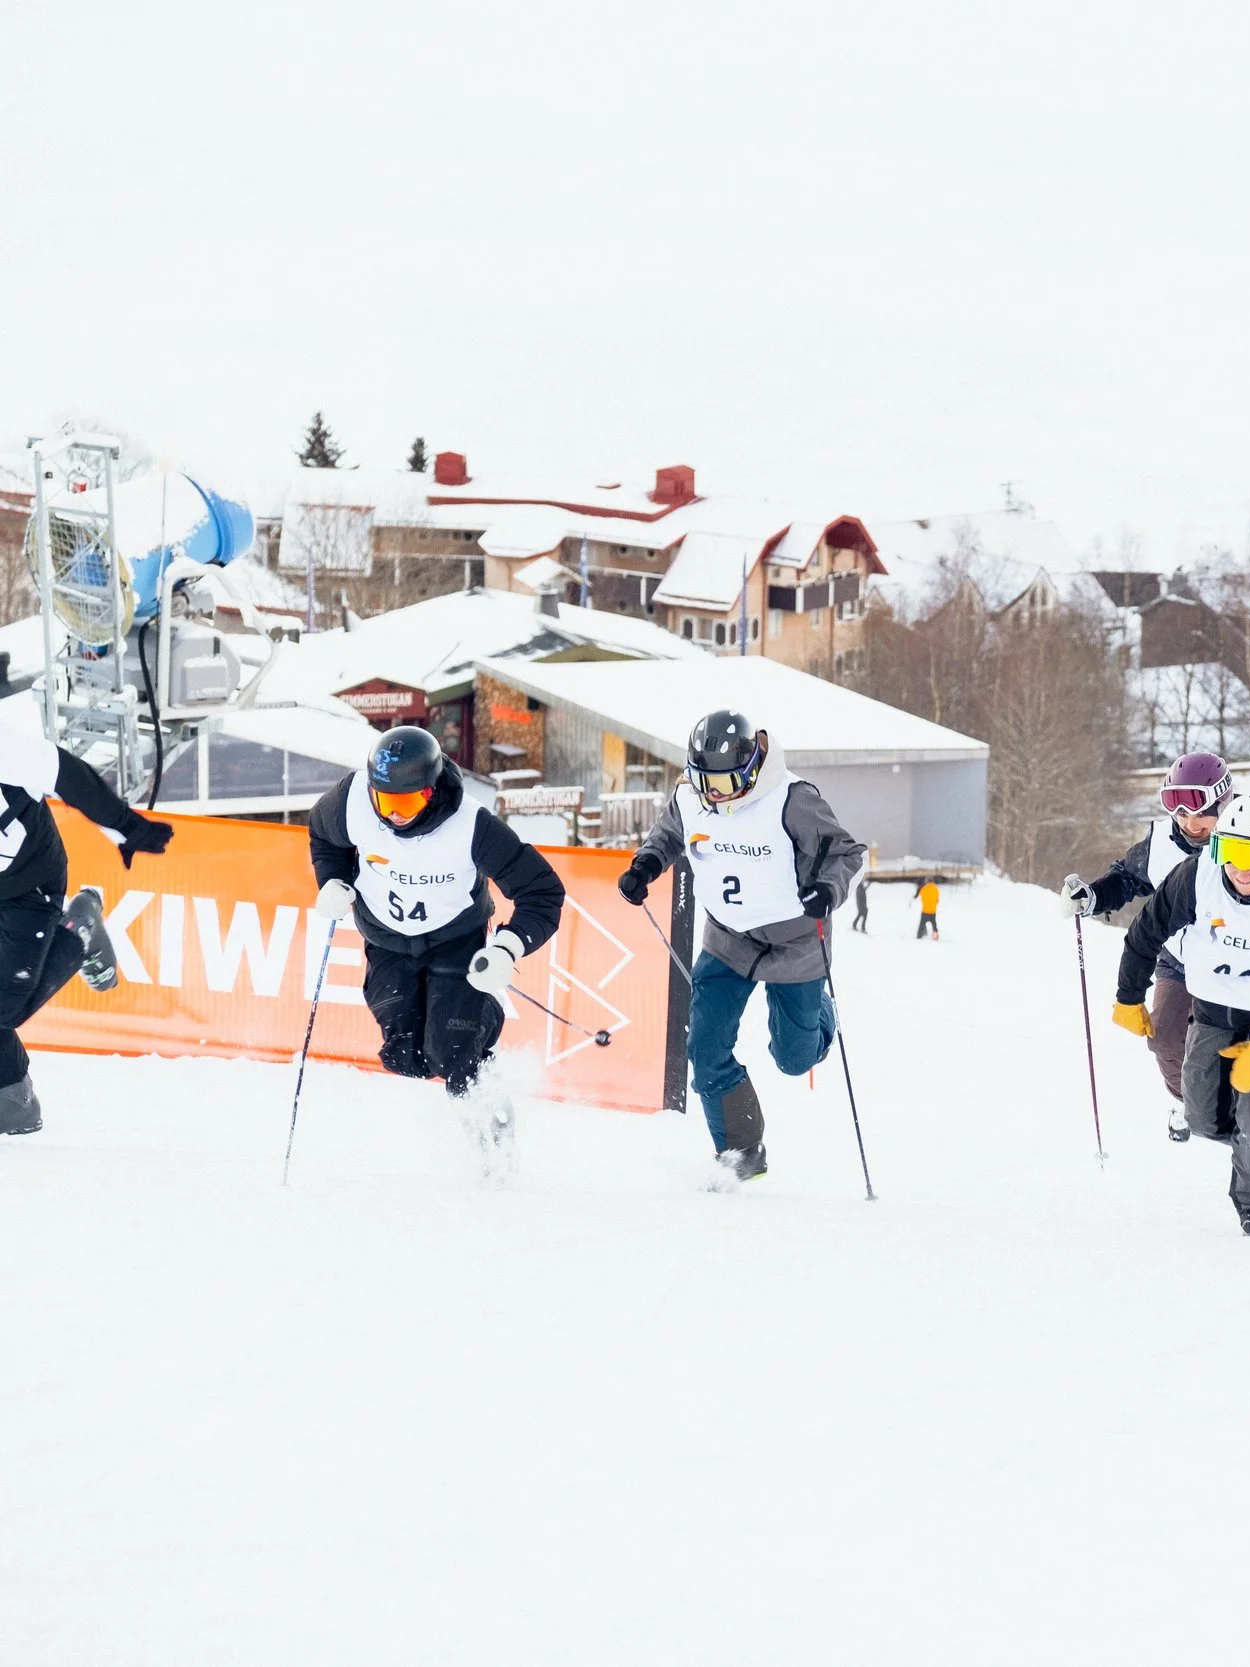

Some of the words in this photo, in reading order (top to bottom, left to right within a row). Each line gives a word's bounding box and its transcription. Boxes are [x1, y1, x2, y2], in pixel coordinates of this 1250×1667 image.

[714, 842, 772, 858] CELSIUS
[389, 870, 455, 885] CELSIUS
[722, 875, 743, 905] 2
[388, 889, 428, 922] 54
